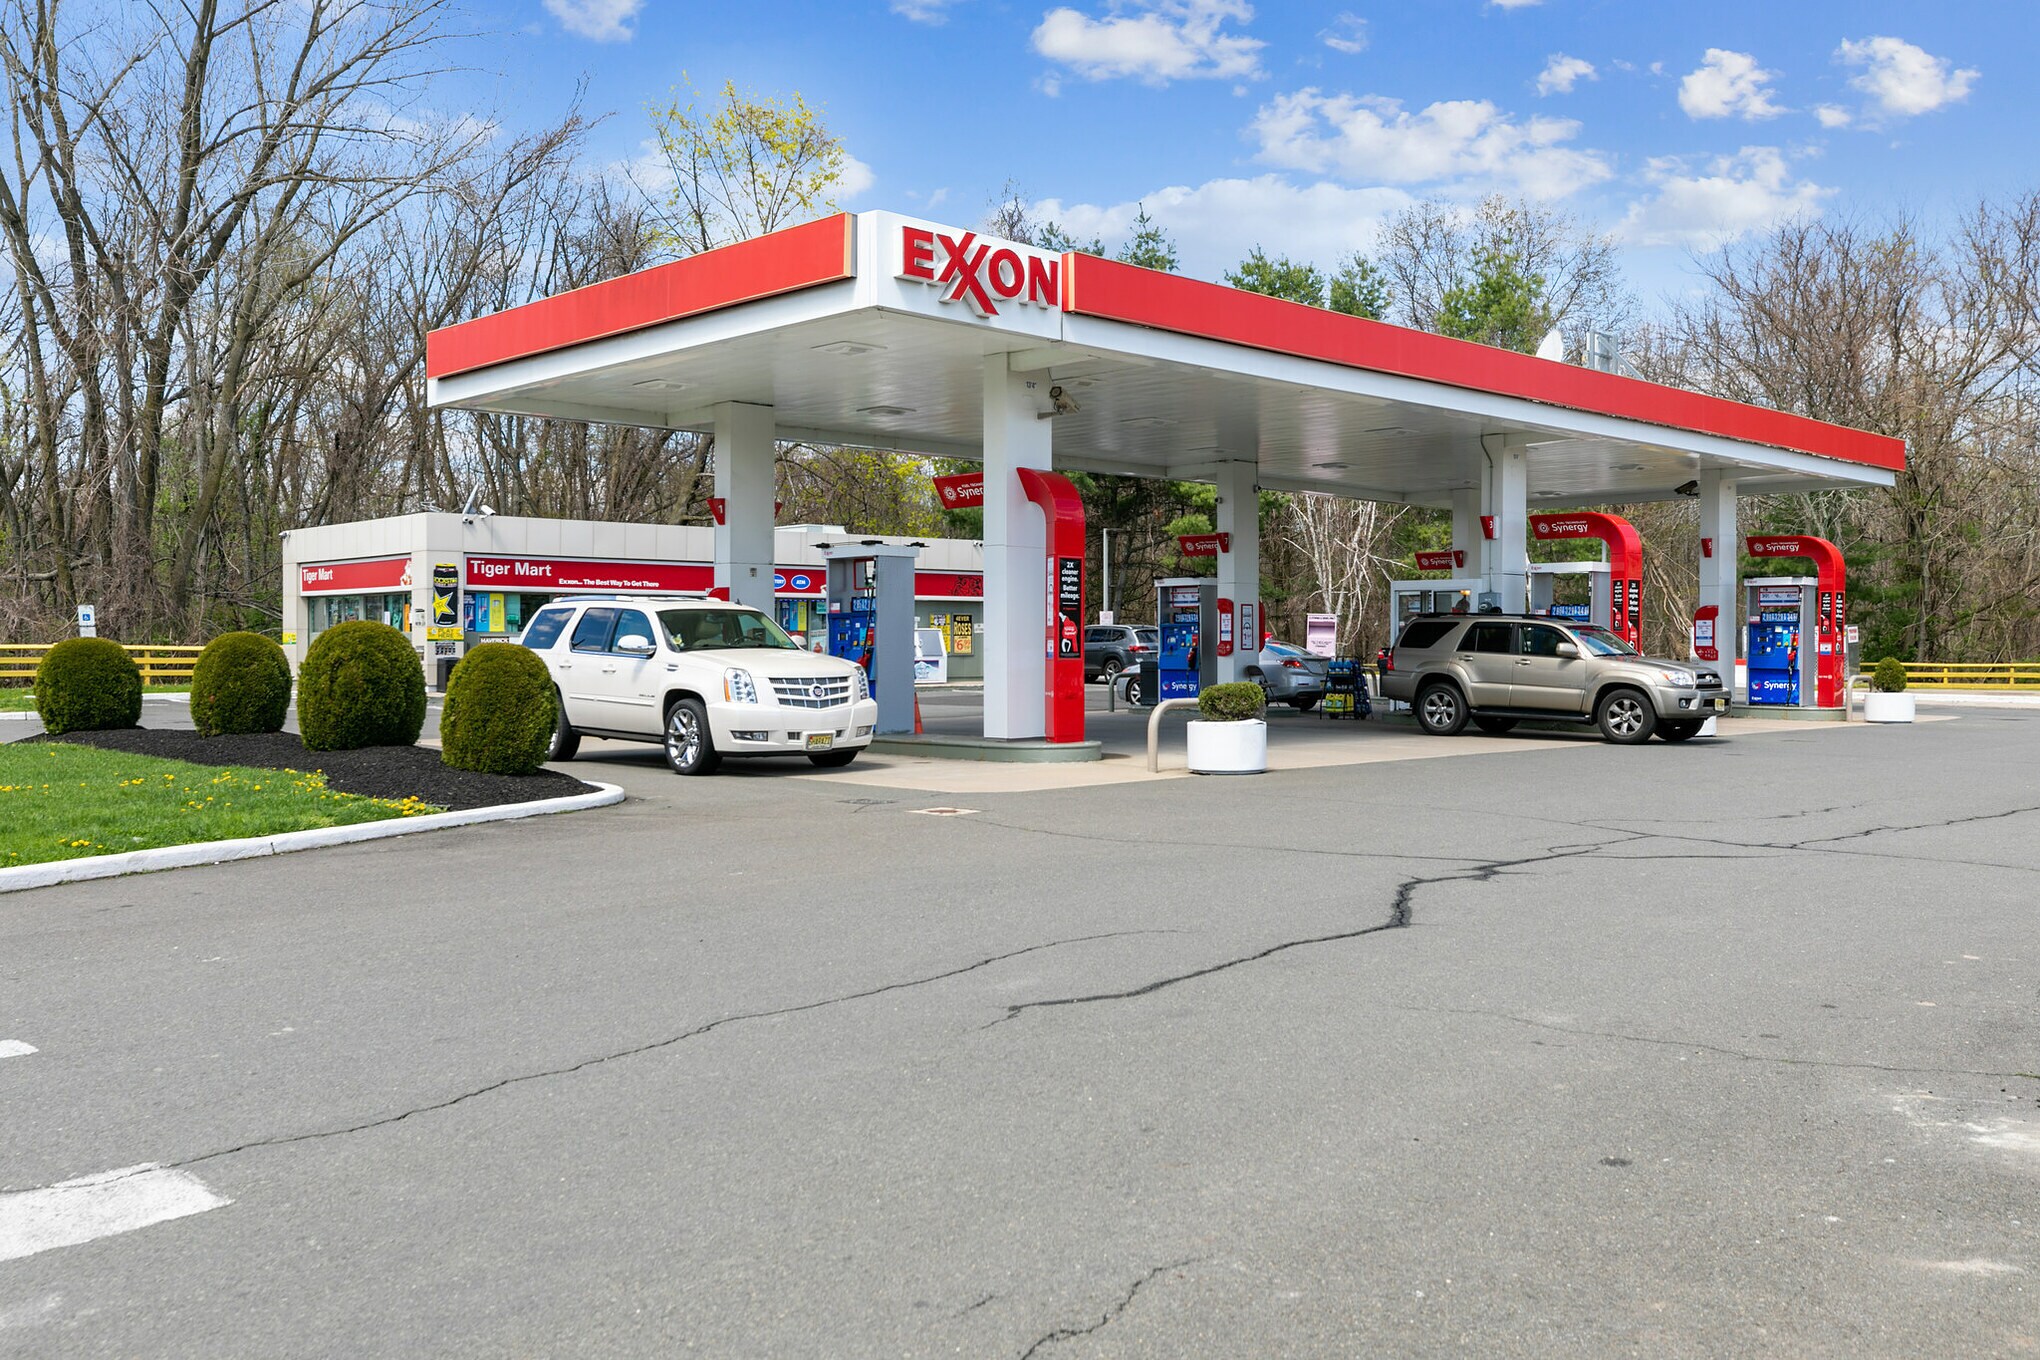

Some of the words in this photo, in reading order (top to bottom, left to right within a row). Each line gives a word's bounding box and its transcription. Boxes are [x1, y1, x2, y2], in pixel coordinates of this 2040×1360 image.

[902, 226, 1058, 315] EXXON
[957, 487, 984, 500] Syner
[1551, 523, 1588, 533] Synergy
[1766, 544, 1800, 553] Synergy
[470, 560, 510, 577] Tiger
[515, 562, 552, 576] Mart
[303, 569, 318, 584] Tiger
[318, 568, 333, 580] Mart
[954, 621, 972, 635] ROSES
